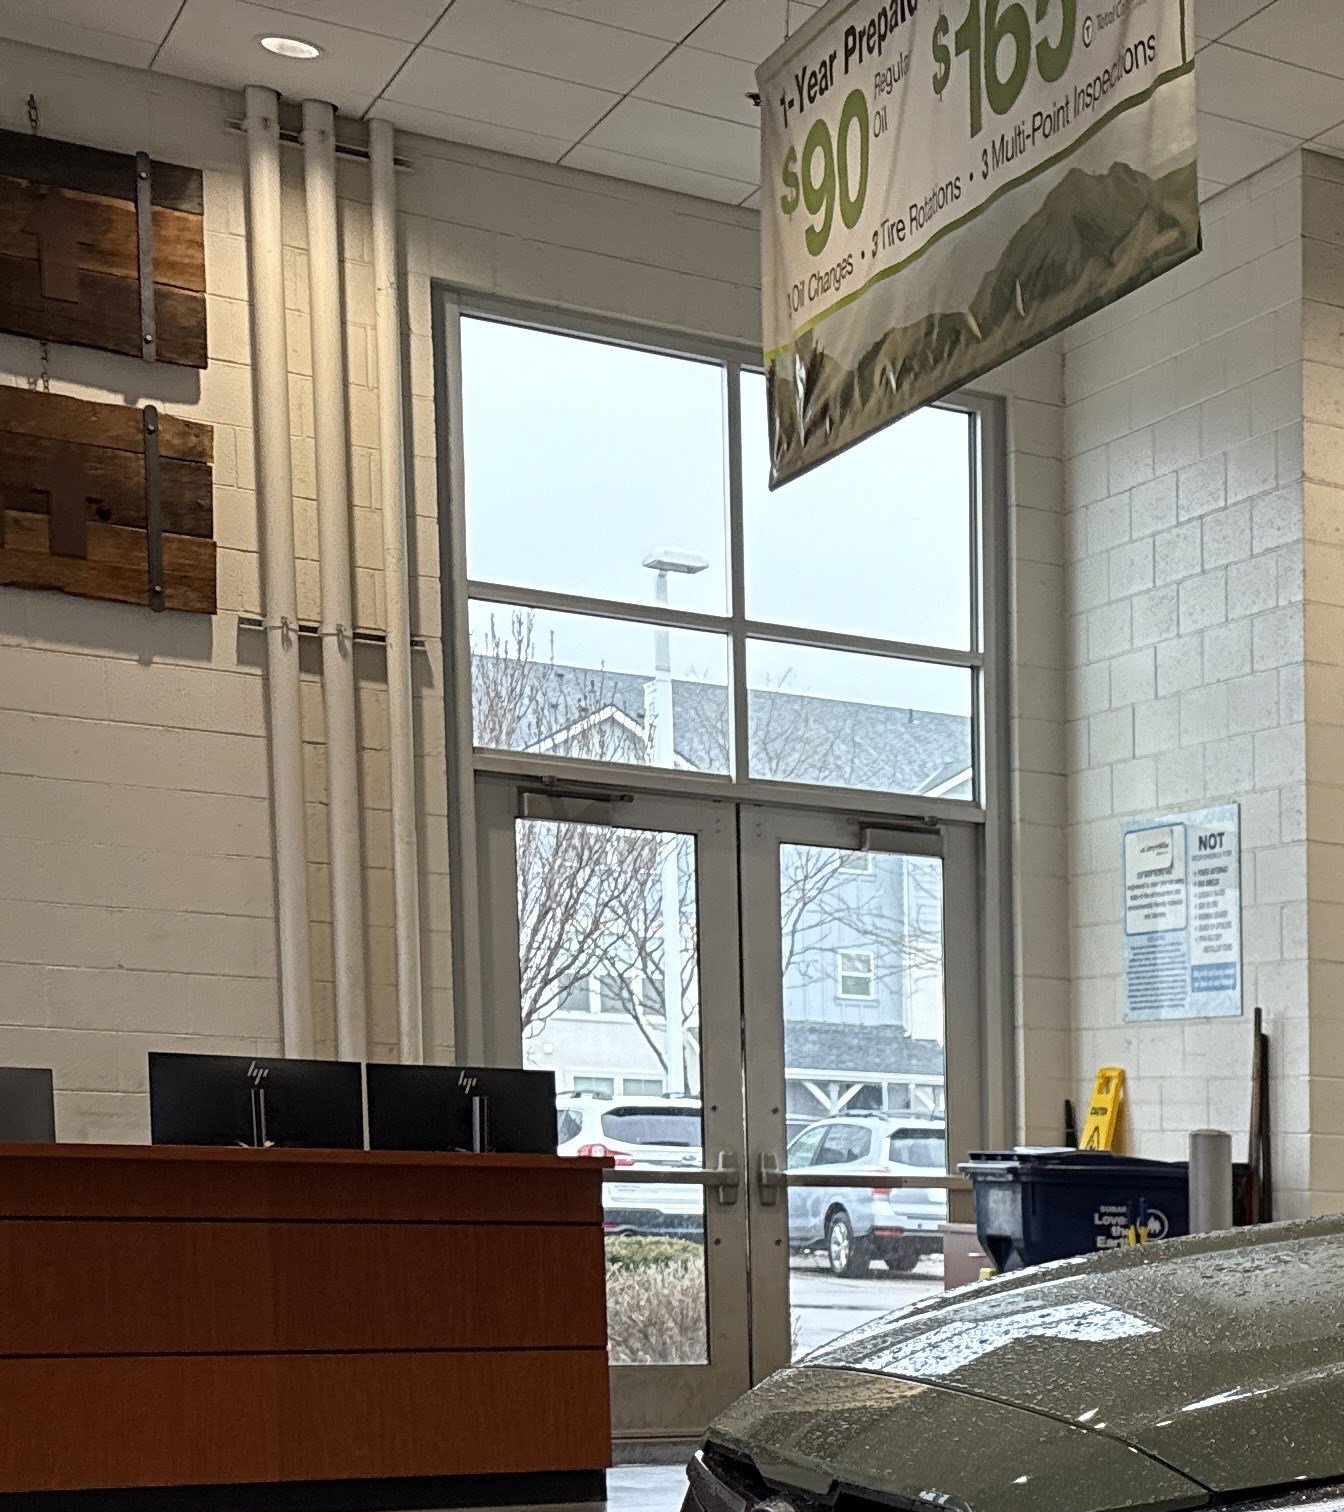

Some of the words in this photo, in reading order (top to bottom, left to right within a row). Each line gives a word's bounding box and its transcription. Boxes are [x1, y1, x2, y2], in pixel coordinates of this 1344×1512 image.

[780, 50, 838, 128] 1-Year
[873, 105, 888, 138] Oil
[780, 89, 870, 256] $90
[808, 253, 854, 301] Changes
[871, 230, 879, 259] 3
[880, 217, 906, 250] Tire
[909, 176, 962, 236] Rotations
[982, 148, 989, 180] 3
[992, 94, 1070, 172] Multi-Point
[1073, 34, 1157, 119] Inspections
[1199, 832, 1225, 852] NOT
[247, 1060, 269, 1085] hp
[458, 1069, 478, 1094] hp
